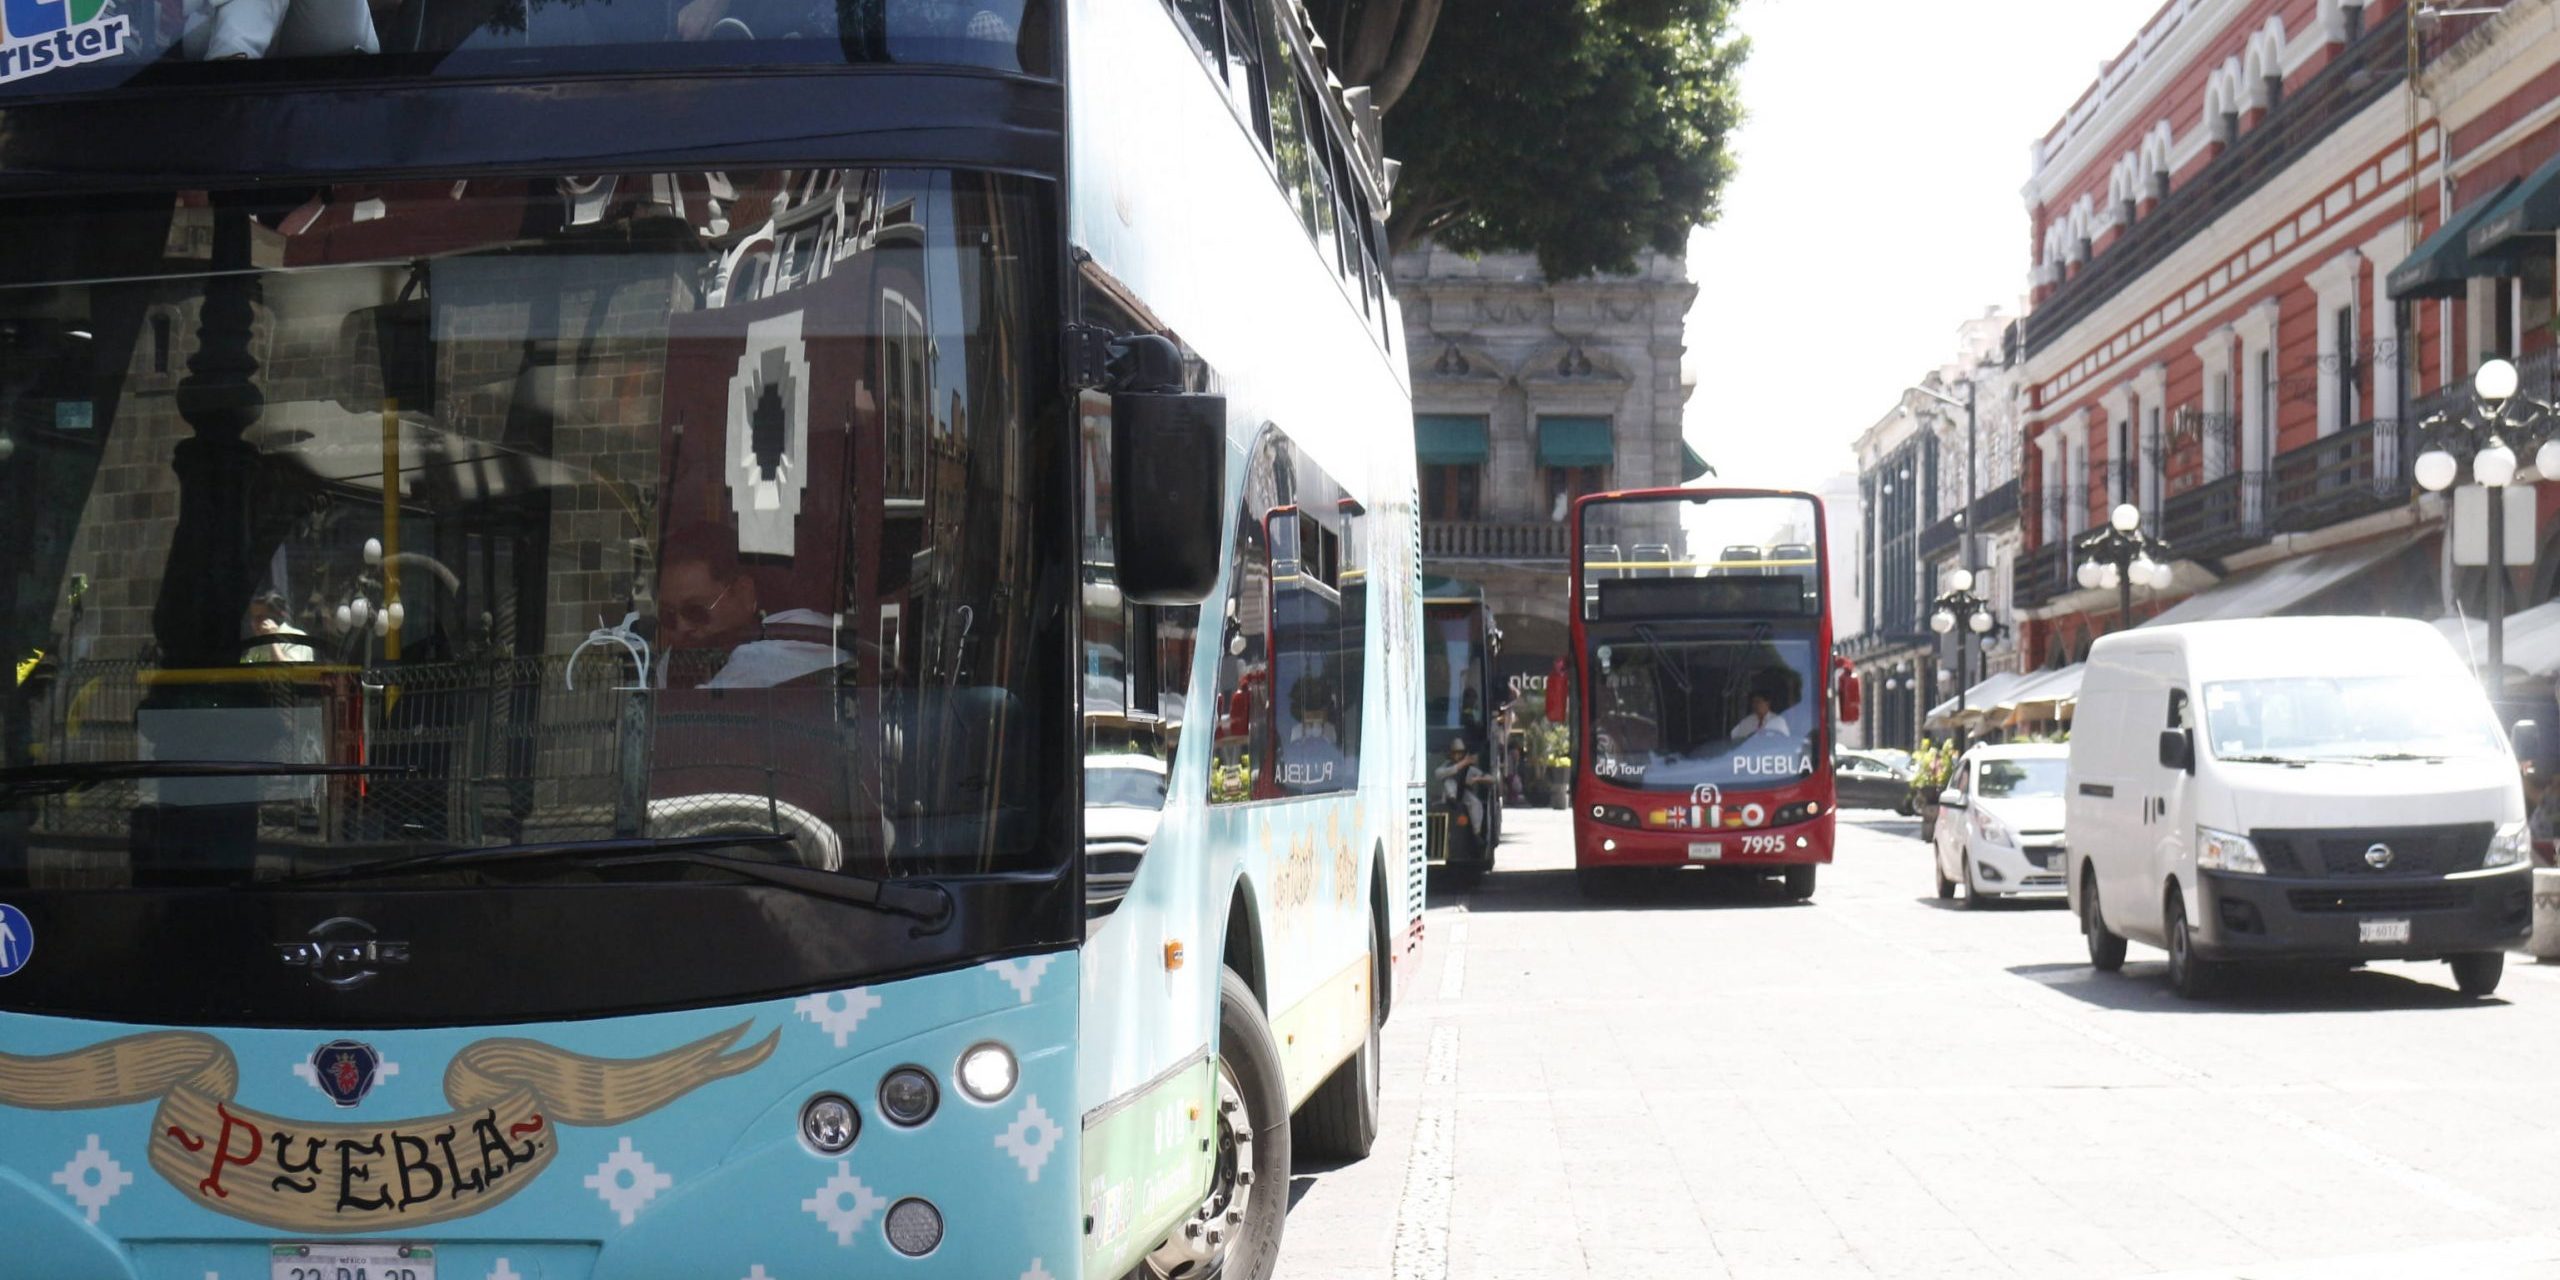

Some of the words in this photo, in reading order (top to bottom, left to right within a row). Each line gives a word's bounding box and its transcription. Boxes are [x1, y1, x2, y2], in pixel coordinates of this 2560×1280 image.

[1595, 759, 1617, 777] City
[1620, 763, 1645, 775] Tour
[1734, 756, 1813, 774] PUEBLA
[1701, 788, 1711, 803] 6
[1741, 835, 1786, 853] 7995
